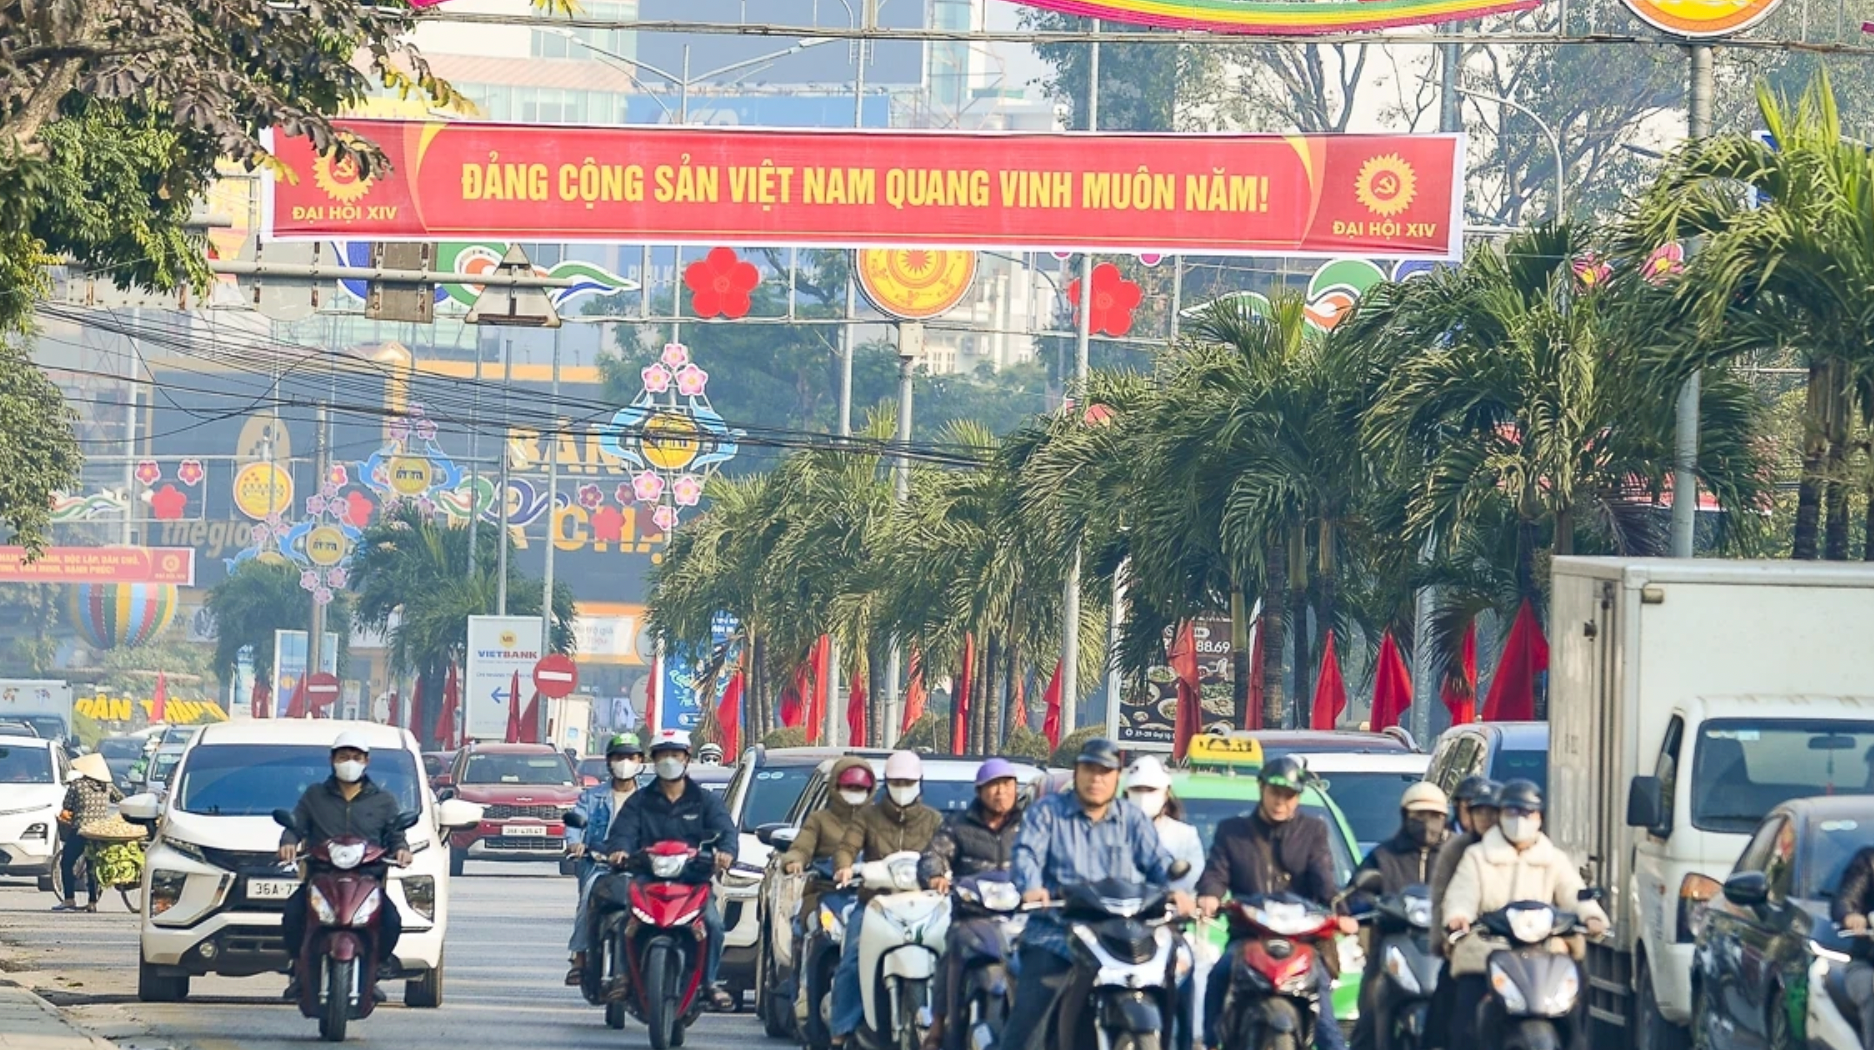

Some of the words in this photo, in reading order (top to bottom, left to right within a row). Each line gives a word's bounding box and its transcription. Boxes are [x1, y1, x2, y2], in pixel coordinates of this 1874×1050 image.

[462, 151, 547, 200] ĐẢNG
[558, 157, 644, 209] CỘNG
[654, 153, 719, 203] SẢN
[728, 159, 793, 211] VIỆT
[803, 167, 876, 205] NAM
[886, 168, 989, 209] QUANG
[1000, 170, 1072, 208] VINH
[1082, 165, 1175, 210] MUÔN
[1185, 167, 1269, 212] NĂM!
[292, 206, 323, 223] ĐẠI
[329, 201, 361, 224] HỘI
[366, 206, 397, 220] XIV
[1332, 220, 1364, 239] ĐẠI
[1369, 218, 1400, 240] HỘI
[1406, 223, 1437, 237] XIV
[477, 650, 538, 659] VIETBANK
